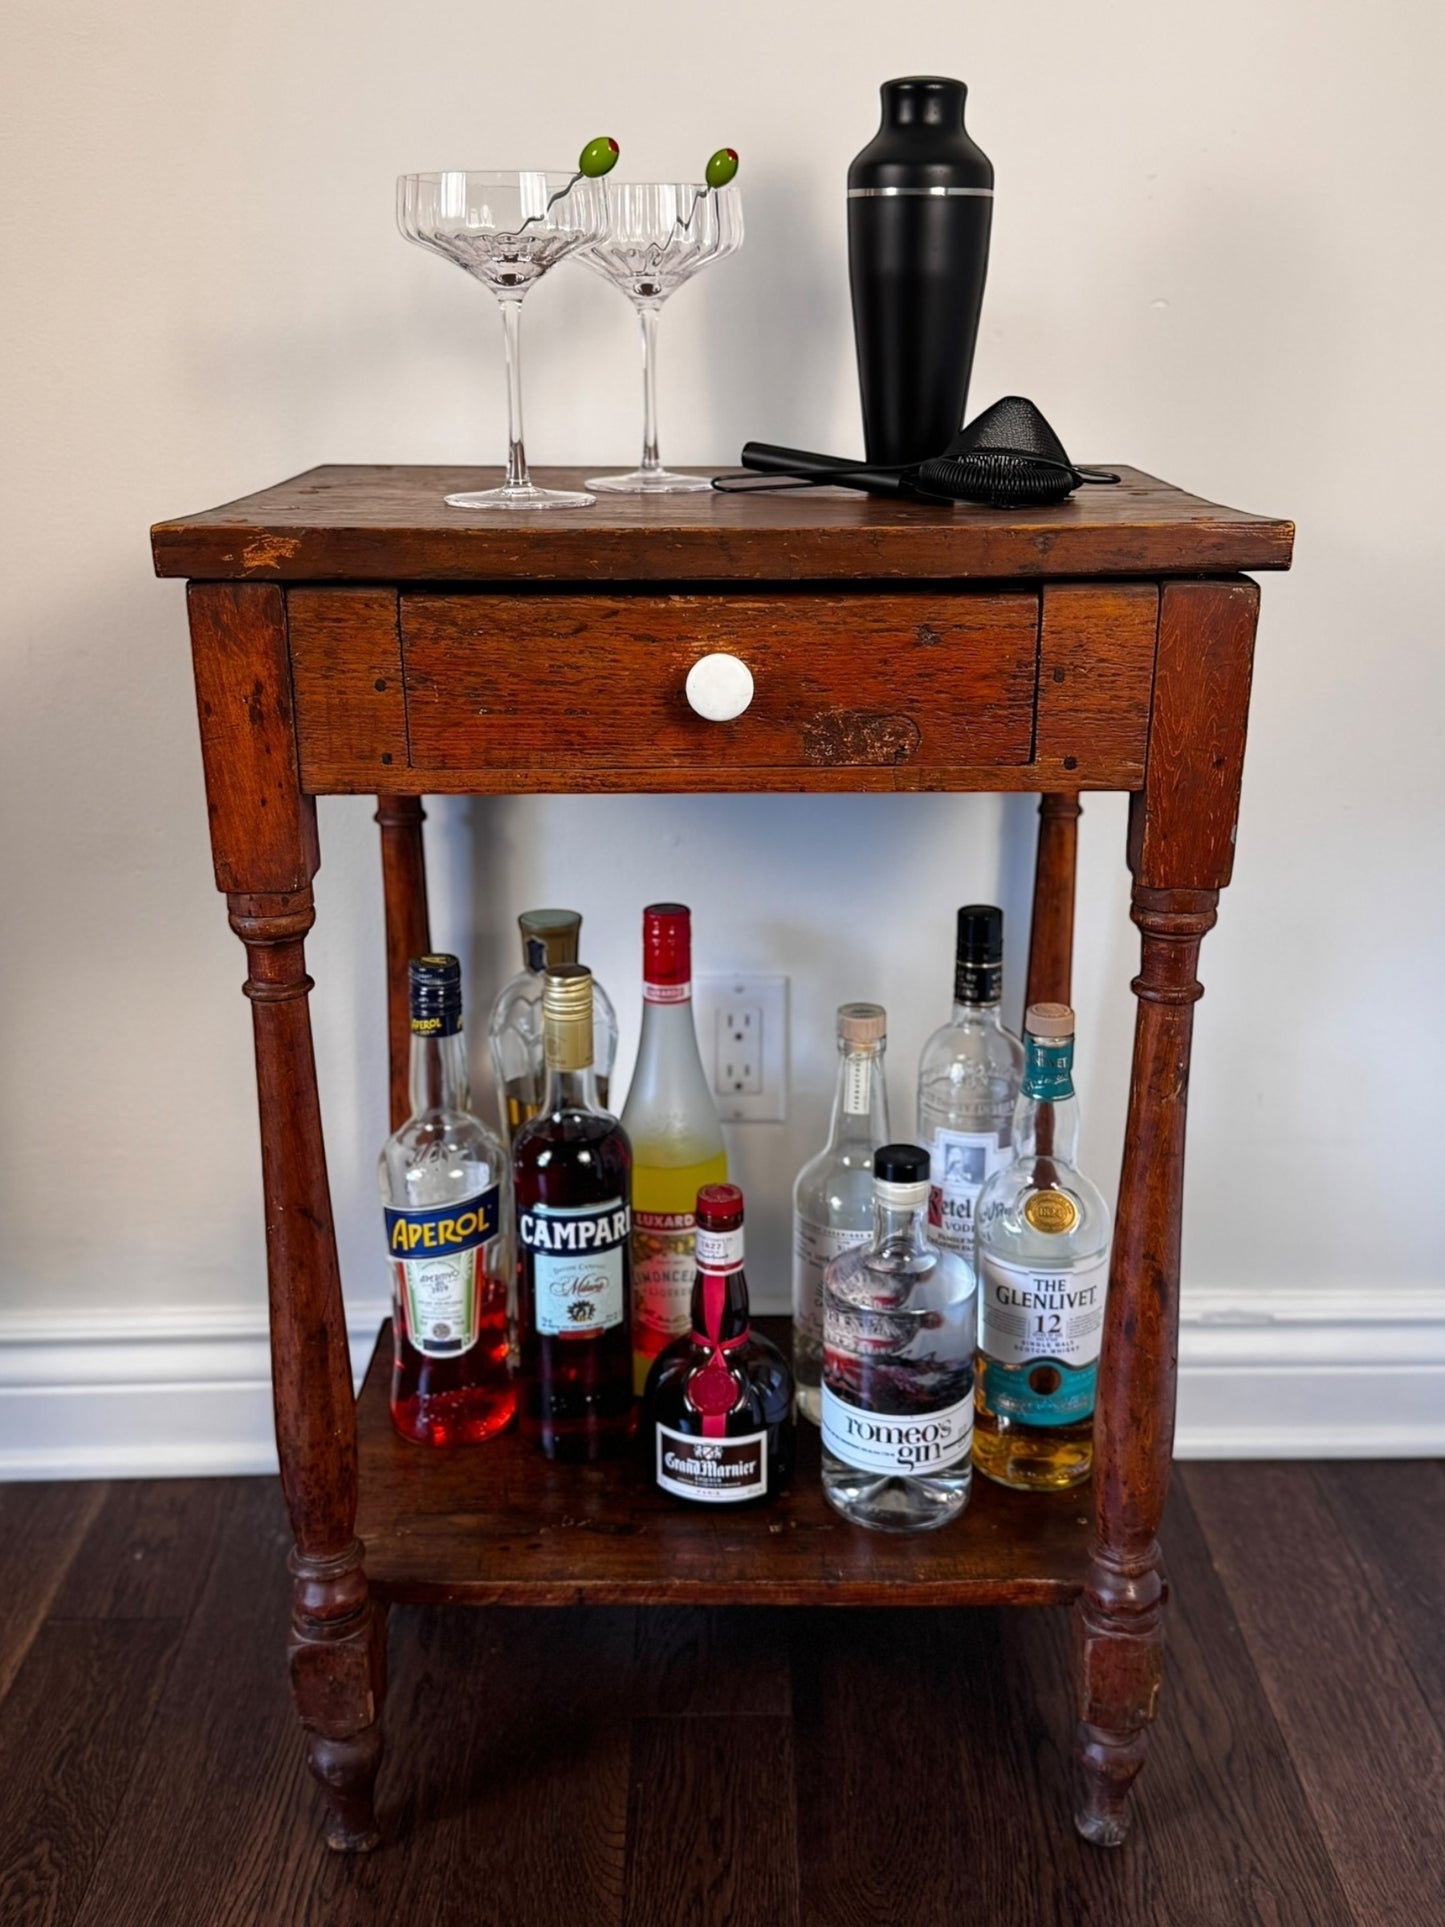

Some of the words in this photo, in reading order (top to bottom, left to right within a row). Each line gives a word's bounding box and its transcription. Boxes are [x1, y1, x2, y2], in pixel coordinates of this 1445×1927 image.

[392, 1207, 490, 1251] APEROL
[520, 1205, 631, 1250] CAMPARI
[636, 1214, 695, 1228] LUXARD
[945, 1221, 974, 1232] VOD
[996, 1285, 1098, 1310] GLENLIVET
[1033, 1278, 1066, 1292] THE
[1035, 1314, 1062, 1333] 12
[845, 1415, 952, 1445] romeo's
[664, 1451, 701, 1475] Grand
[701, 1459, 757, 1478] Marnier
[897, 1442, 941, 1472] gin
